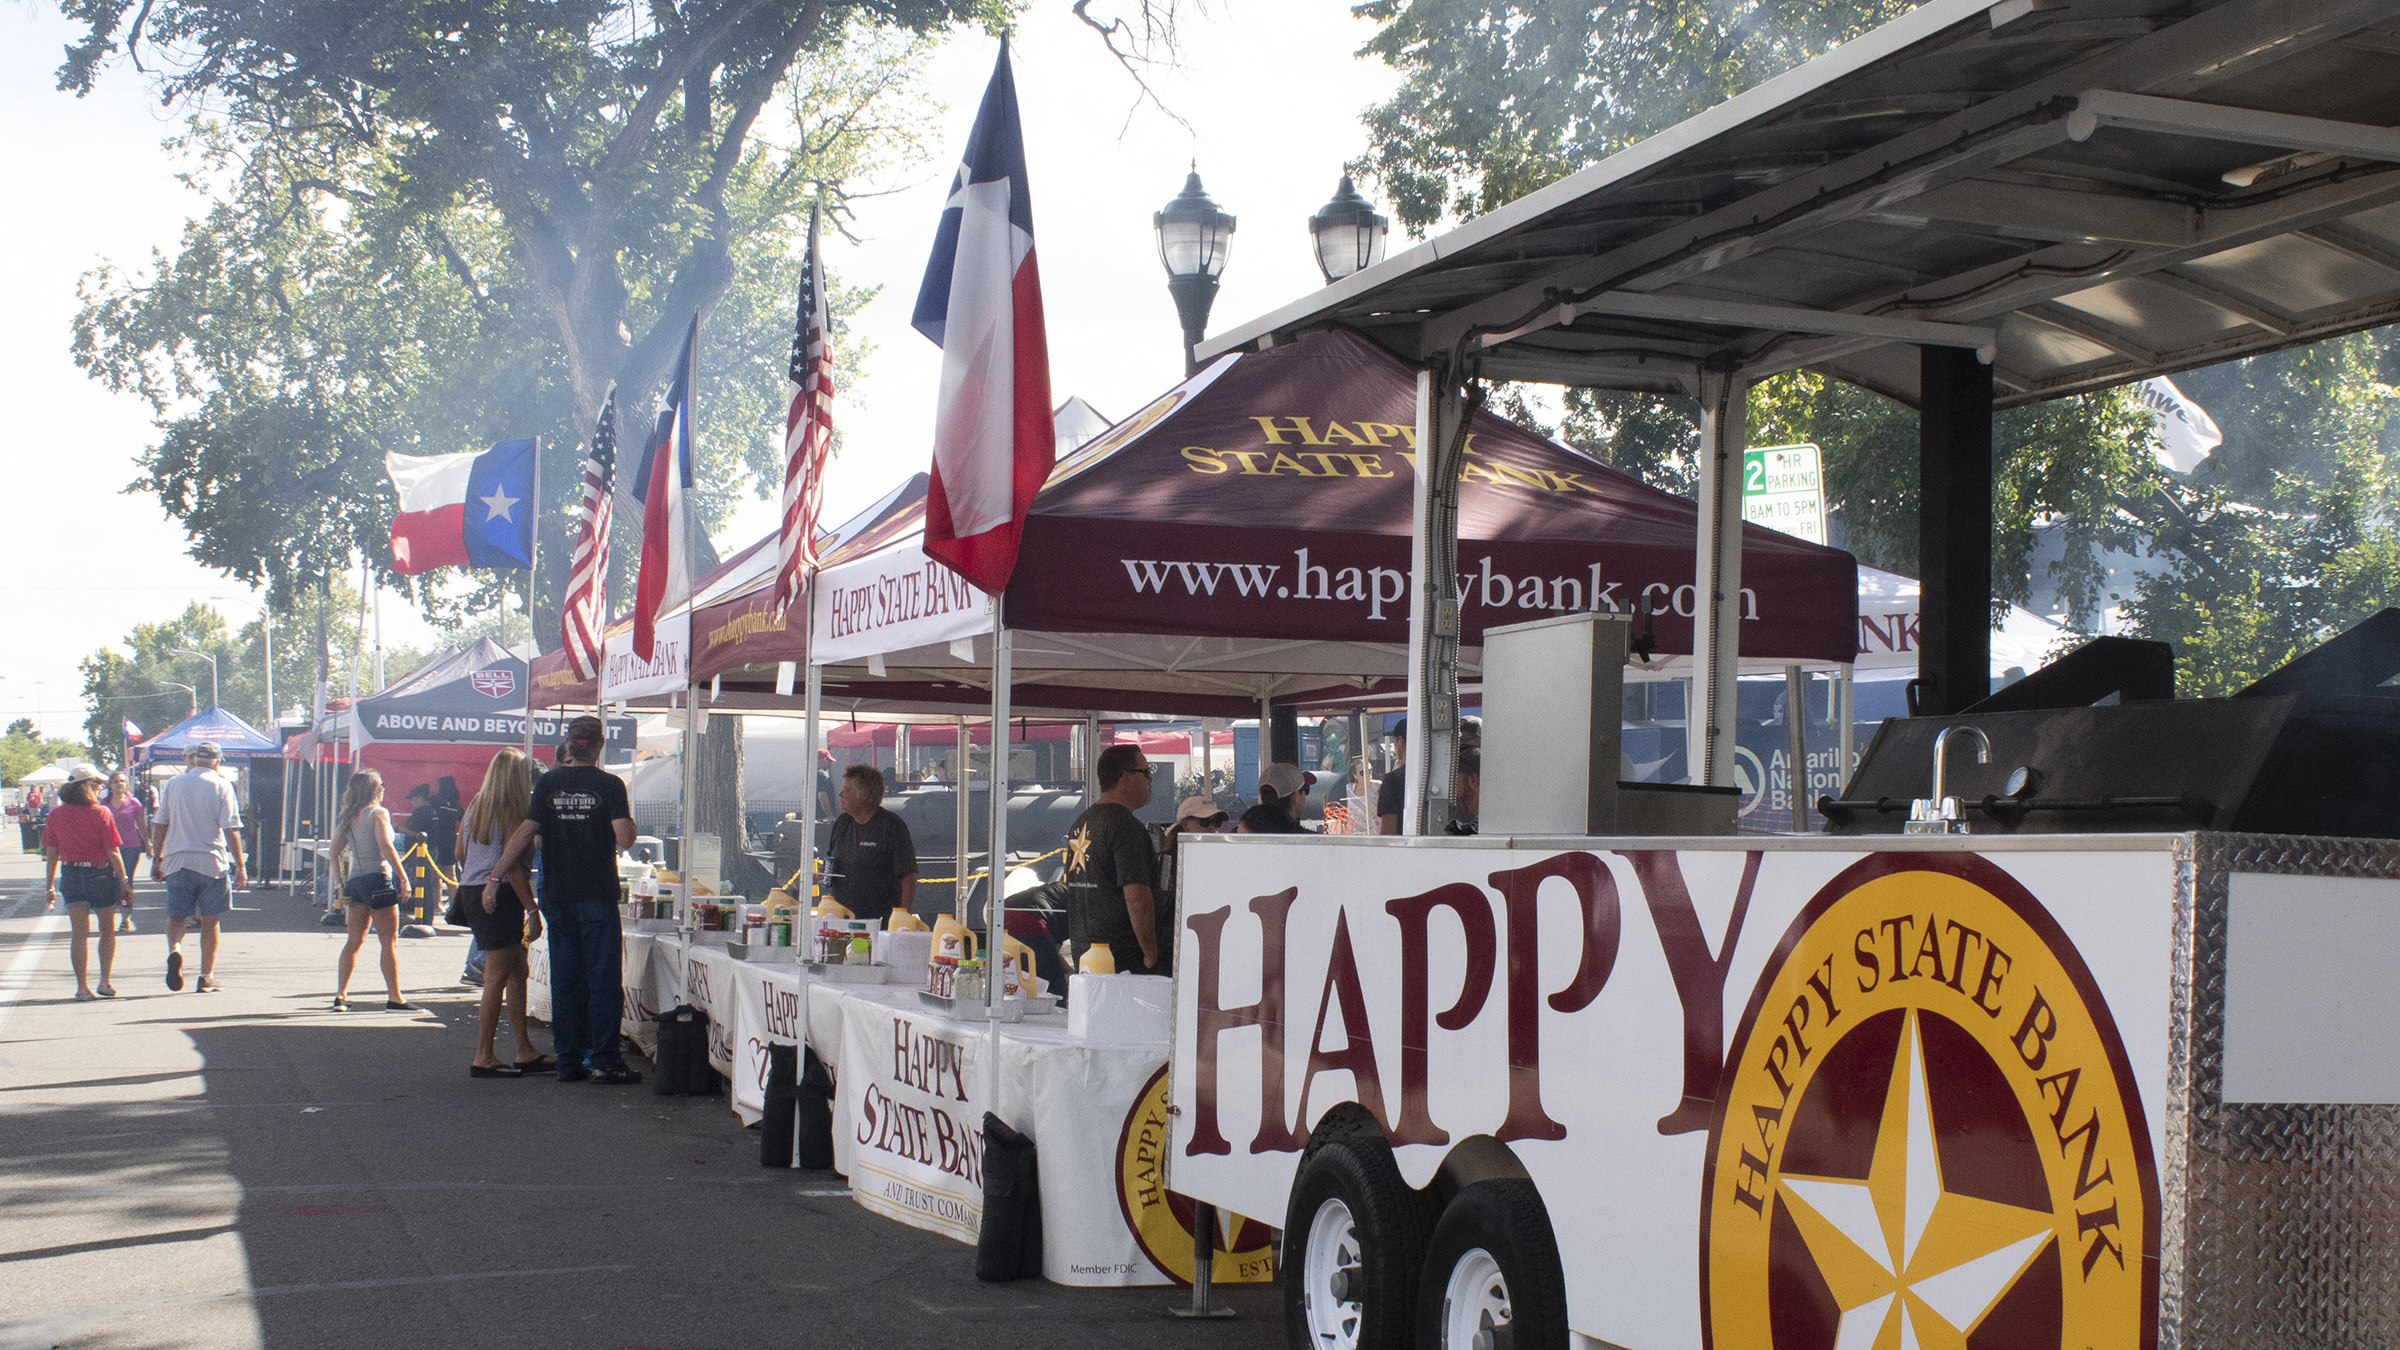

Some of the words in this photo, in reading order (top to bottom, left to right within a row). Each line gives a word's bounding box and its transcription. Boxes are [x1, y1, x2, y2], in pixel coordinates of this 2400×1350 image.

[1181, 447, 1394, 479] STATE
[1397, 452, 1603, 493] ANK
[1746, 460, 1764, 491] 2
[1782, 454, 1802, 469] HR
[1768, 472, 1816, 489] PARKING
[1750, 503, 1773, 519] 8AM
[1777, 501, 1790, 517] TO
[1794, 499, 1817, 515] 5PM
[1800, 521, 1817, 535] FRI
[831, 584, 876, 639] HAPPY
[876, 571, 922, 628] STATE
[1120, 548, 1760, 620] www.hapybank.co
[1858, 613, 1920, 653] NK
[475, 671, 510, 680] BELL
[608, 653, 632, 688] HAPPY
[651, 641, 679, 677] BANK
[376, 714, 438, 731] ABOVE
[441, 716, 481, 732] AND
[1769, 747, 1861, 769] Aarilo
[762, 980, 808, 1043] HAPP
[1185, 850, 1764, 1157] HAPPY
[893, 1017, 969, 1103] HAPPY
[1734, 953, 1842, 1220] HAPPY
[1853, 912, 2012, 1019] STATE
[2009, 985, 2125, 1283] BANK
[857, 1082, 933, 1166] STATE
[930, 1106, 986, 1189] BAN
[1136, 1109, 1166, 1210] HAPPY
[883, 1180, 903, 1201] AND
[903, 1187, 936, 1213] TRUST
[1070, 1263, 1111, 1274] Member
[1114, 1263, 1137, 1274] FDIC
